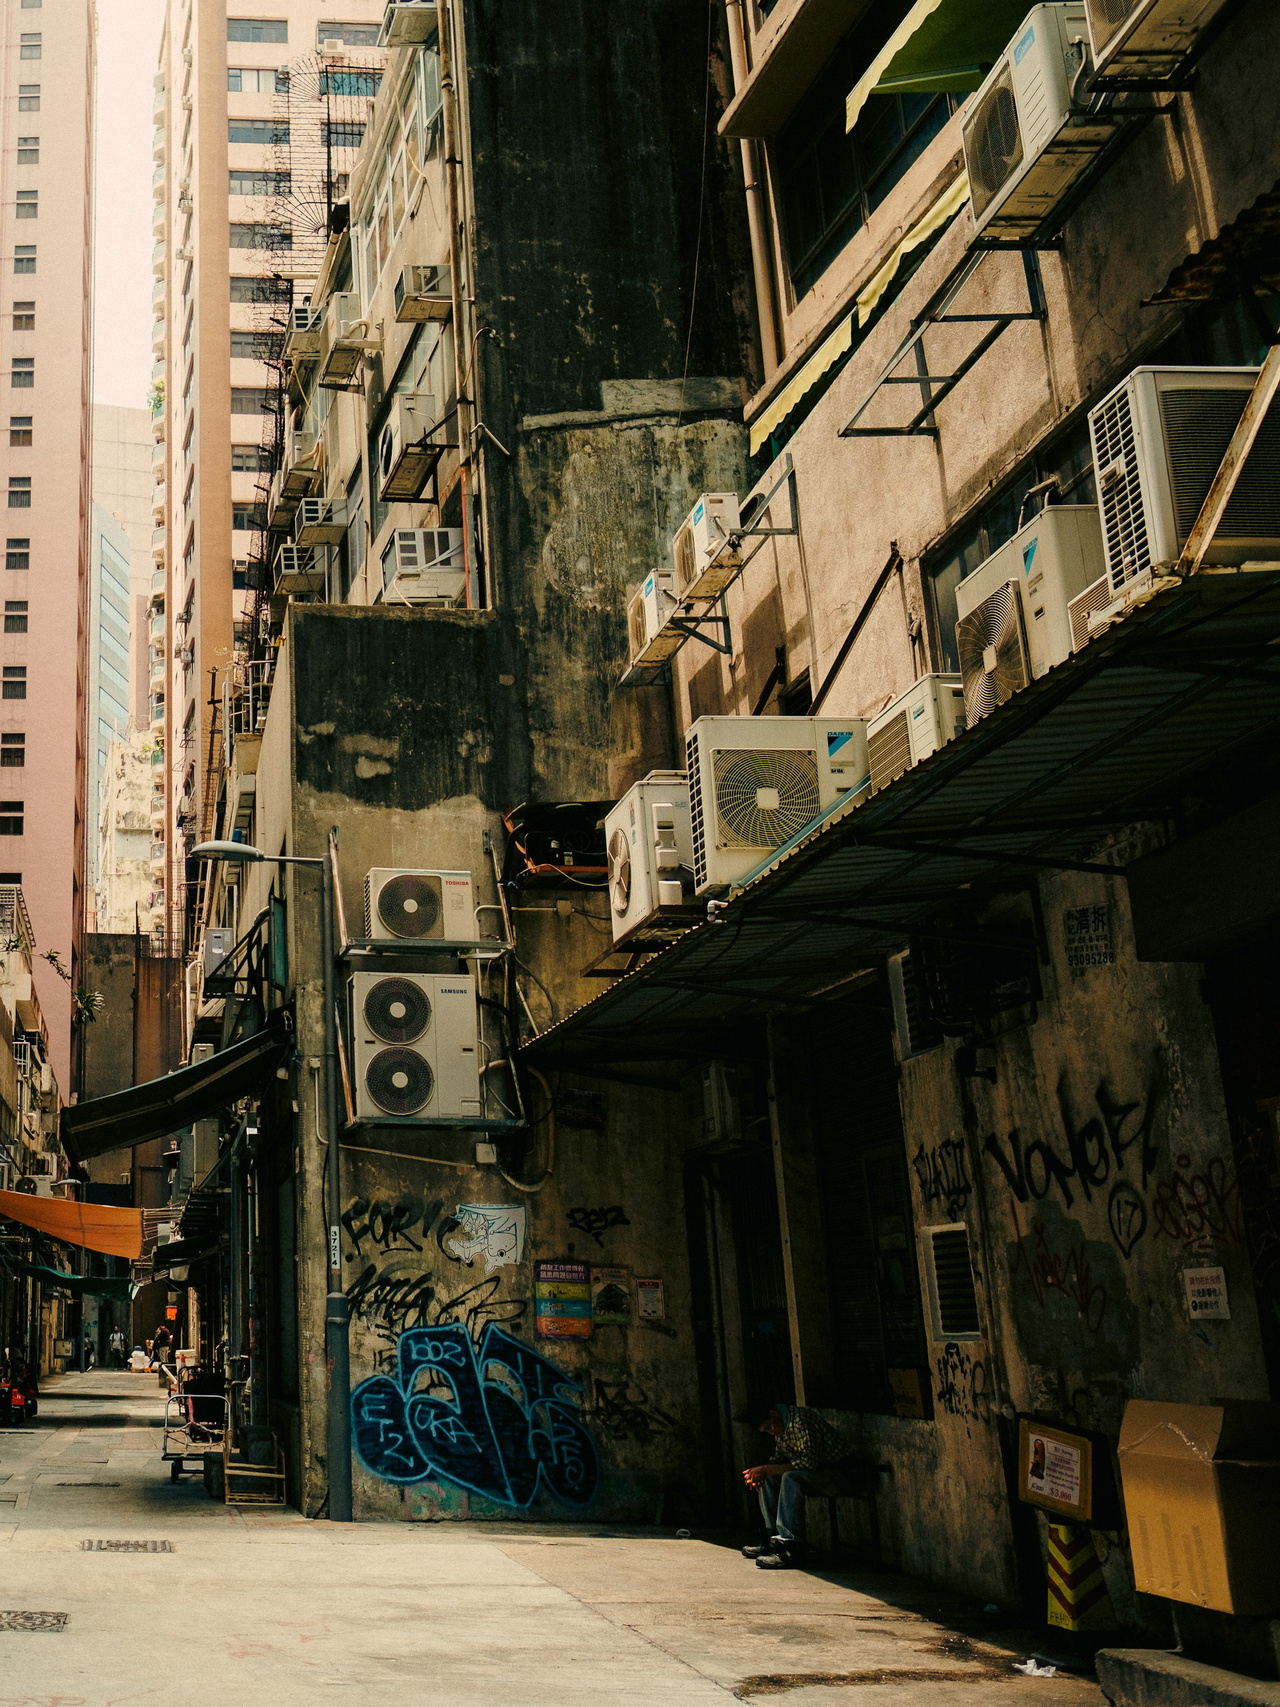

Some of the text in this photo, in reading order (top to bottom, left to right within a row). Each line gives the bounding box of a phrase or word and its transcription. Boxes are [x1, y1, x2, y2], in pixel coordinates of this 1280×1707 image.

[1075, 905, 1107, 934] 清拆
[1067, 952, 1115, 966] 93095288
[1115, 1198, 1136, 1240] 17
